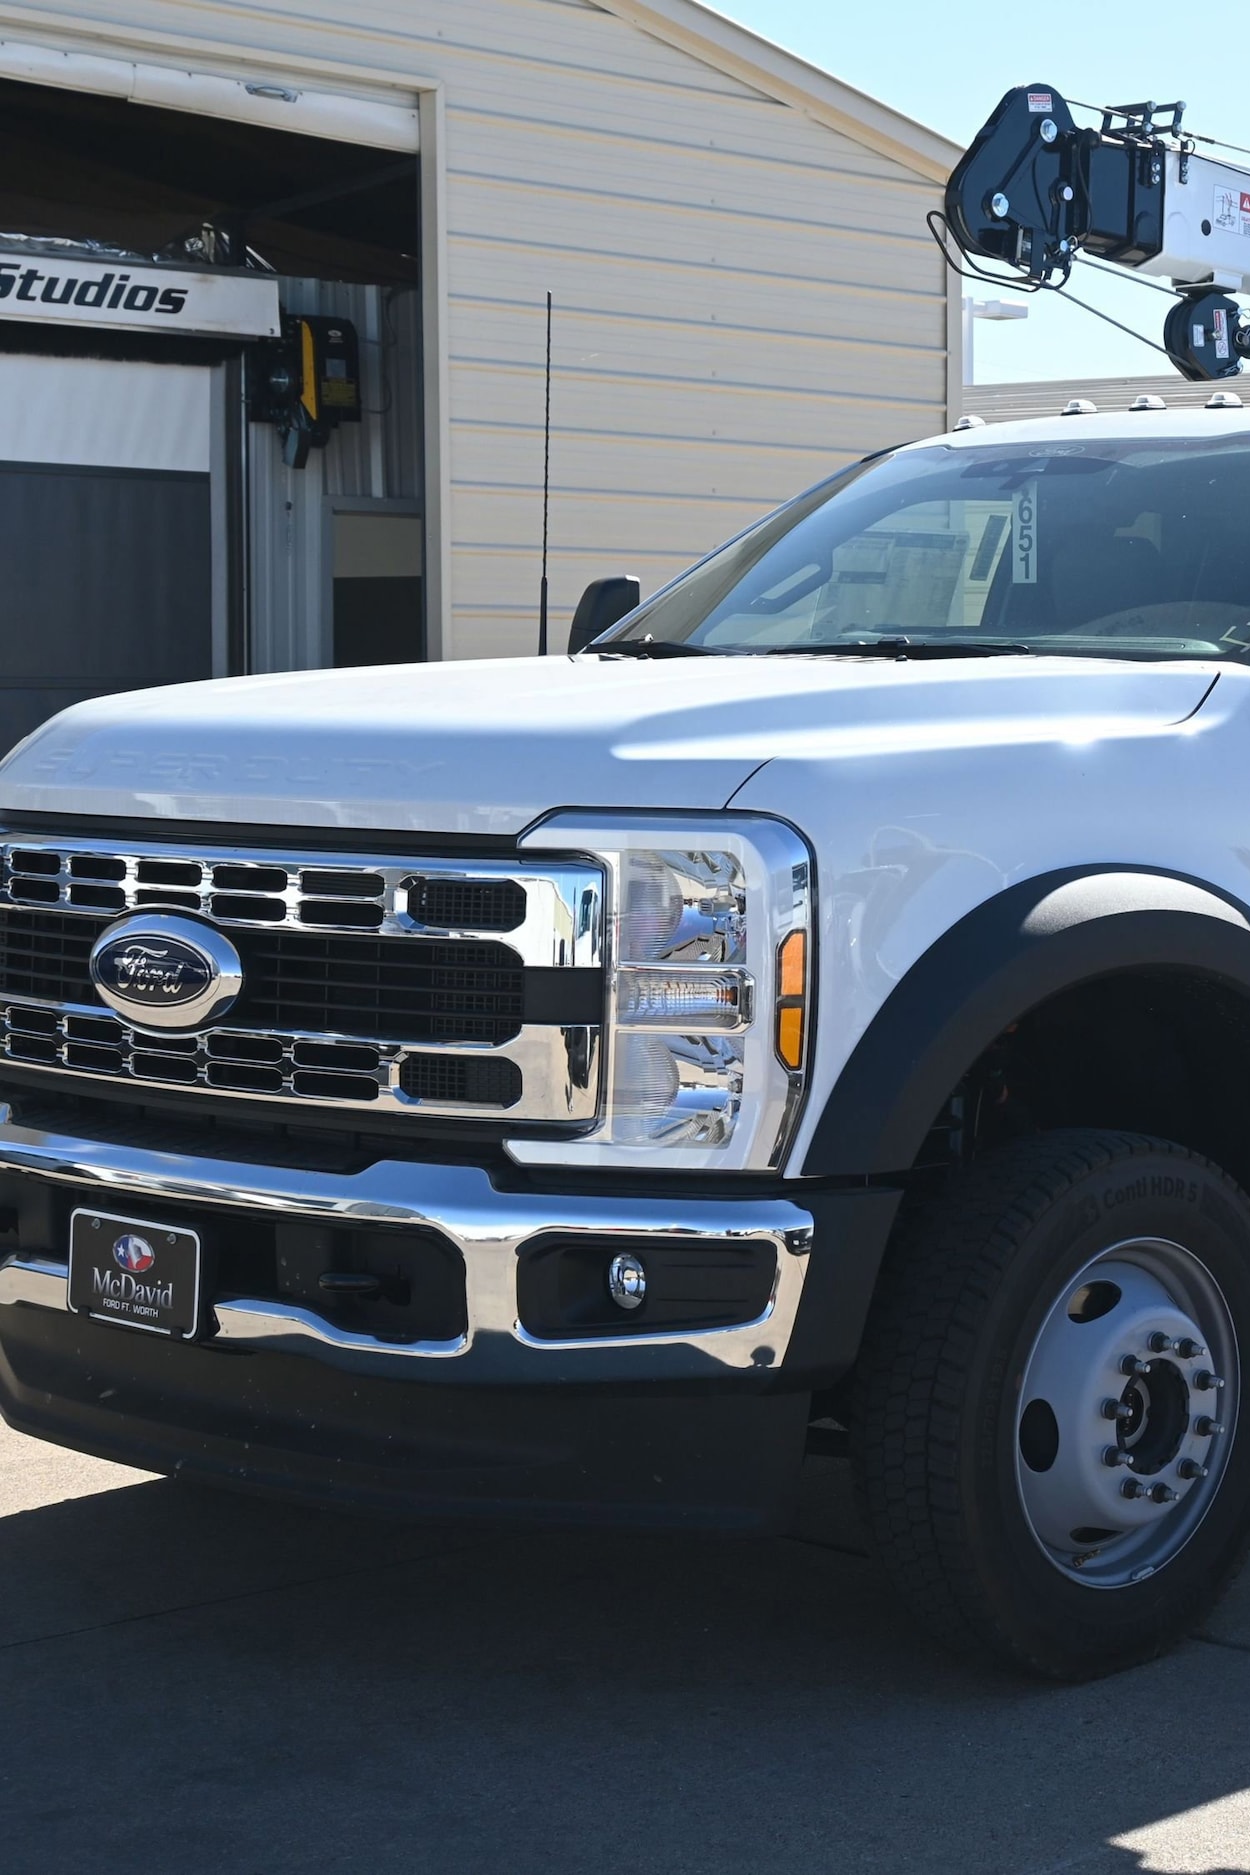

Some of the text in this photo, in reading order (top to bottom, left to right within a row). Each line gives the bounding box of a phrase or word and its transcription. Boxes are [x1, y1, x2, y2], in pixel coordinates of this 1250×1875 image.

[0, 262, 189, 314] Studios
[113, 944, 183, 994] Ford
[92, 1266, 174, 1309] McDavid
[103, 1297, 159, 1318] FORD FT. WORTH
